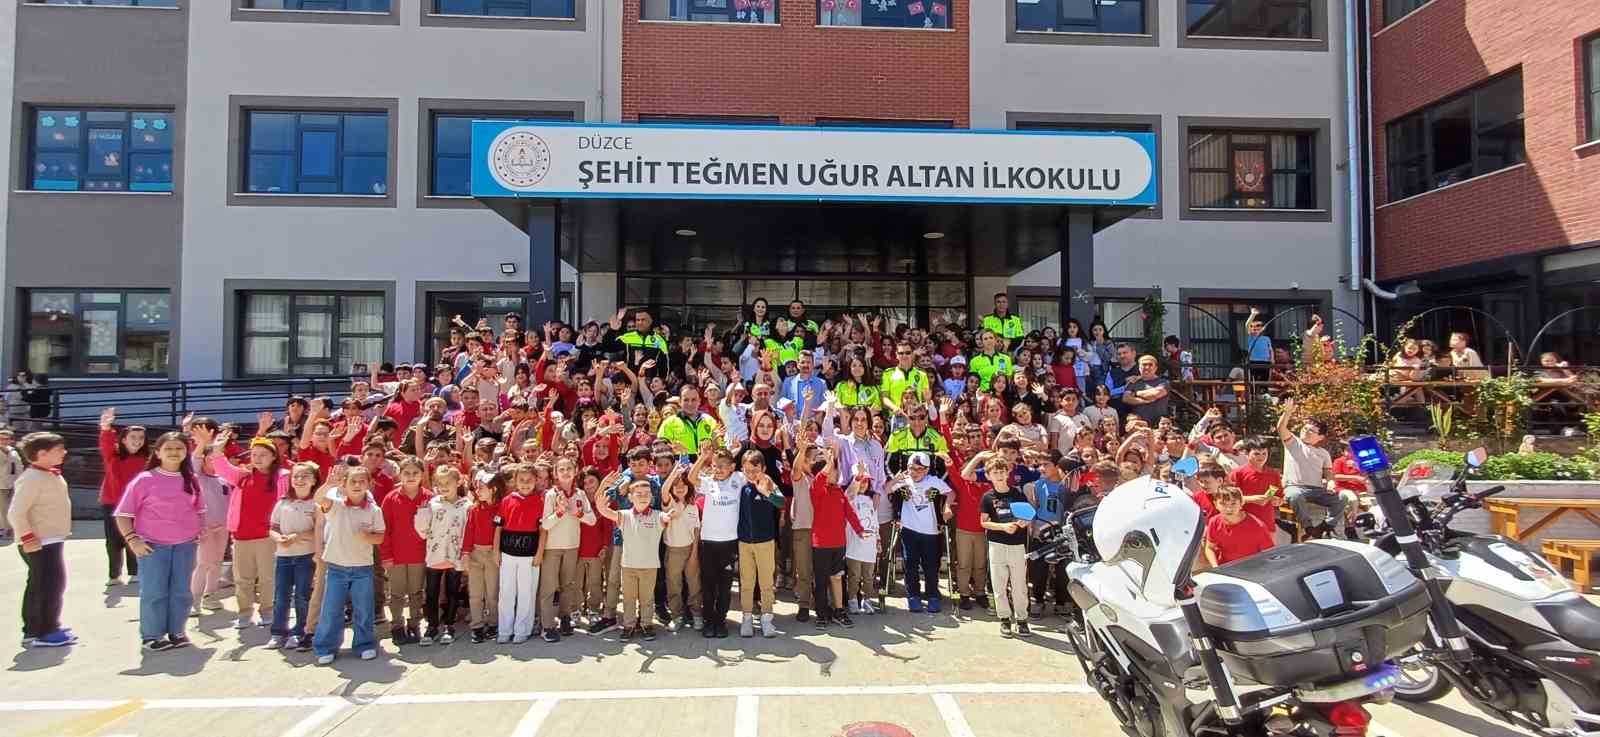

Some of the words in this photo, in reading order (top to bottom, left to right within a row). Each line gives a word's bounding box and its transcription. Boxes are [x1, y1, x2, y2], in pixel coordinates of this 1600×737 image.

[578, 134, 633, 150] DÜZCE
[578, 155, 662, 189] ŞEHİT
[667, 157, 788, 185] TEĞMEN
[797, 158, 879, 186] UĞUR
[886, 164, 974, 188] ALTAN
[983, 161, 1120, 191] İLKOKULU
